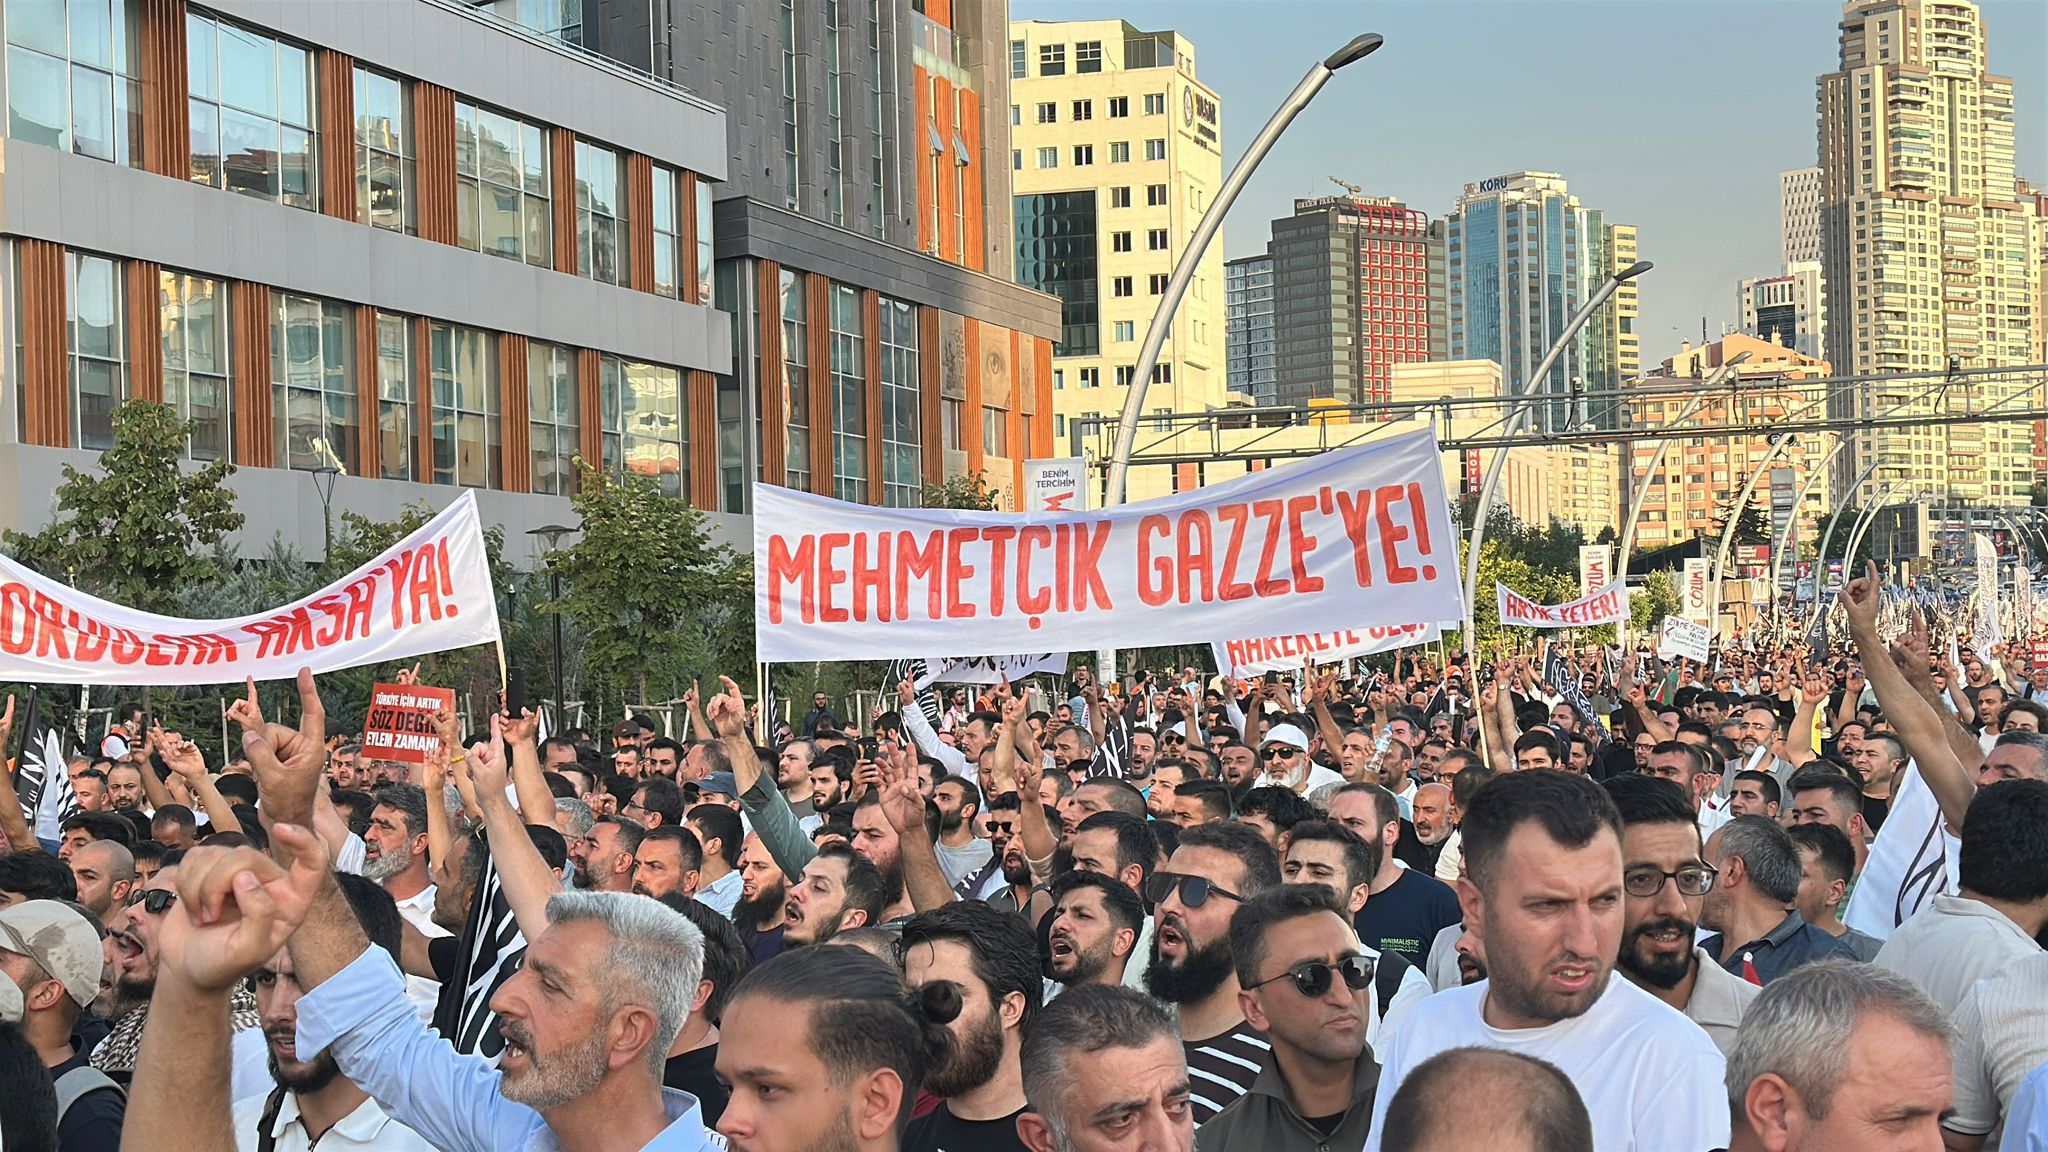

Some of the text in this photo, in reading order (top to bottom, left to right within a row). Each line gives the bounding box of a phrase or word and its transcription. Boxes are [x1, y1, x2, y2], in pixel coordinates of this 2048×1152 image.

[1480, 177, 1507, 192] KORU
[1297, 197, 1335, 209] GREEN PARK
[1353, 197, 1391, 207] GREEN PARK
[1042, 469, 1069, 478] BENİM
[1470, 450, 1478, 492] NOTER
[1036, 479, 1075, 488] TERCİHİM
[1137, 481, 1437, 607] GAZZE'YE!
[1690, 571, 1704, 608] ÇÖZÜM
[1559, 590, 1620, 623] YETER!
[375, 691, 441, 709] TÜRKİYE İÇİN ARTIK
[370, 705, 394, 729] SÖZ
[365, 731, 393, 747] EYLEM
[1381, 938, 1419, 946] MINIMALISTIC
